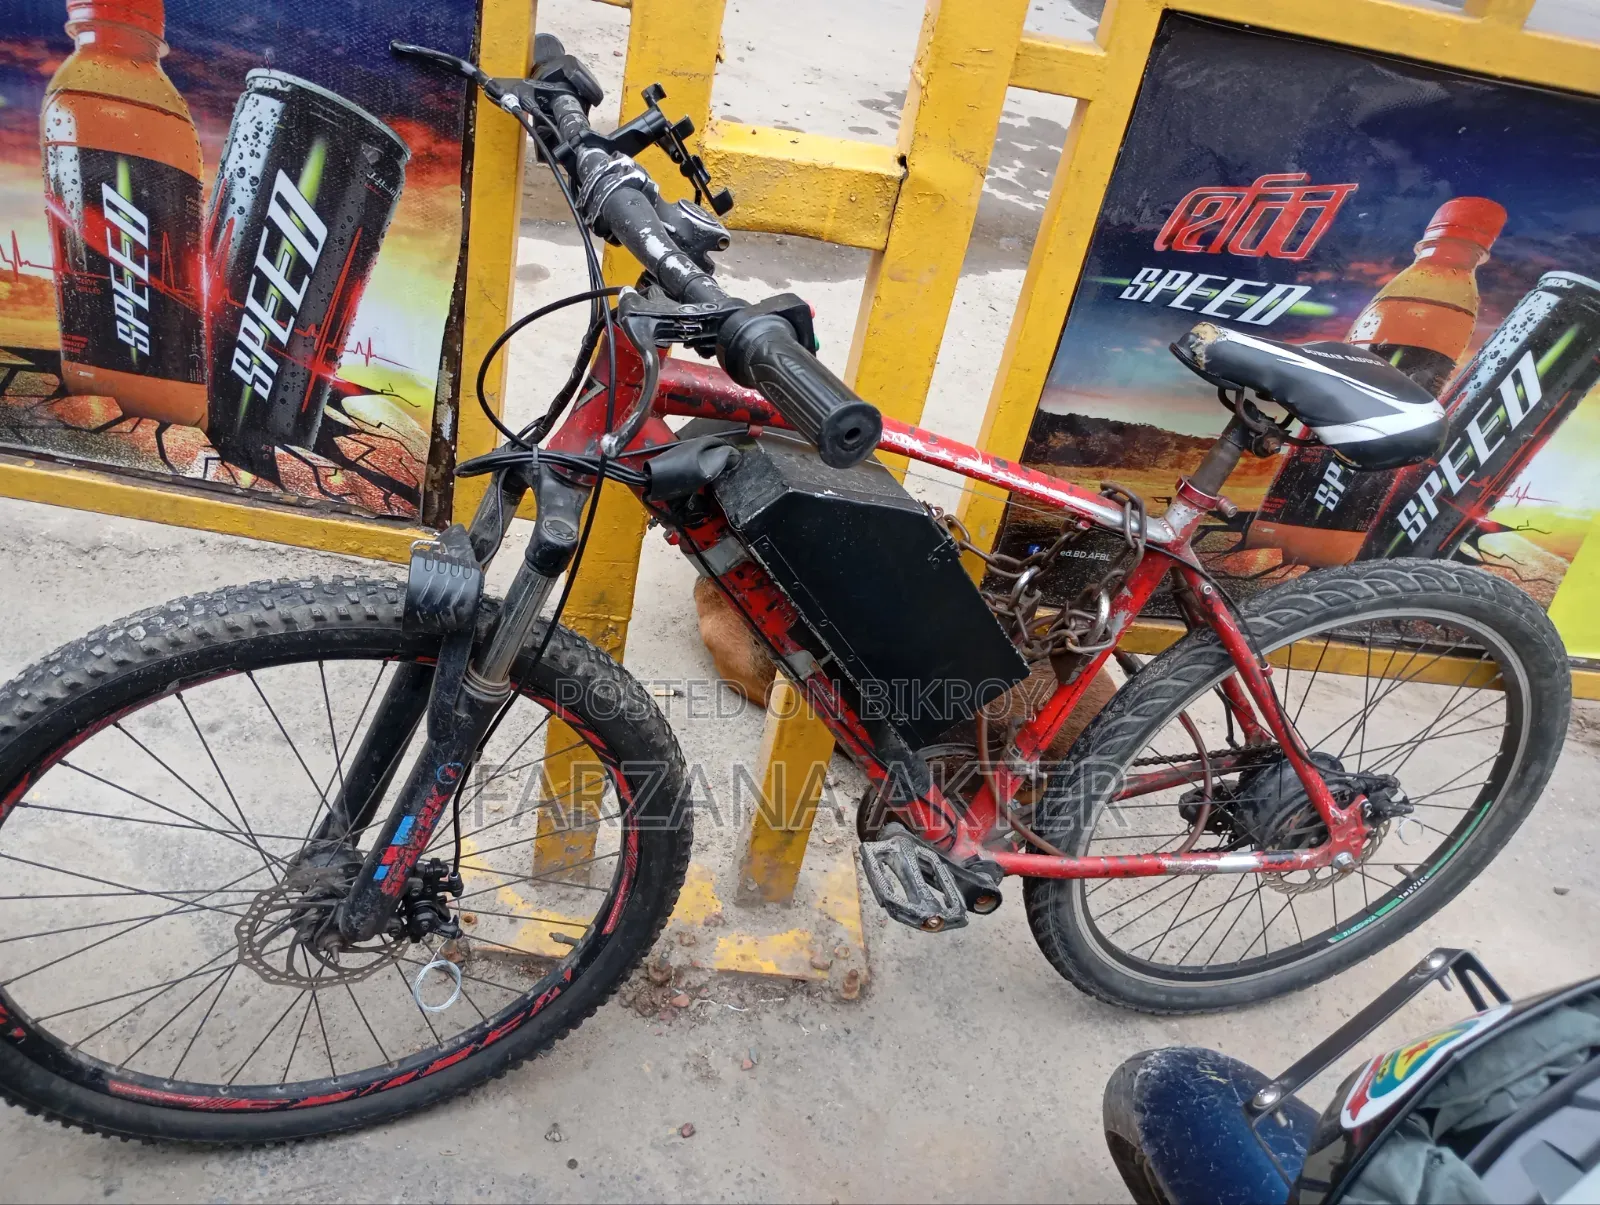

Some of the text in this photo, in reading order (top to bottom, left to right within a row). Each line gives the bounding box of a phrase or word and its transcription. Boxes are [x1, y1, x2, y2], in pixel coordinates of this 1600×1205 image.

[102, 182, 150, 356] SPEED
[231, 169, 328, 402] SPEED
[1119, 267, 1312, 325] SPEED
[1396, 350, 1543, 544] SPEED
